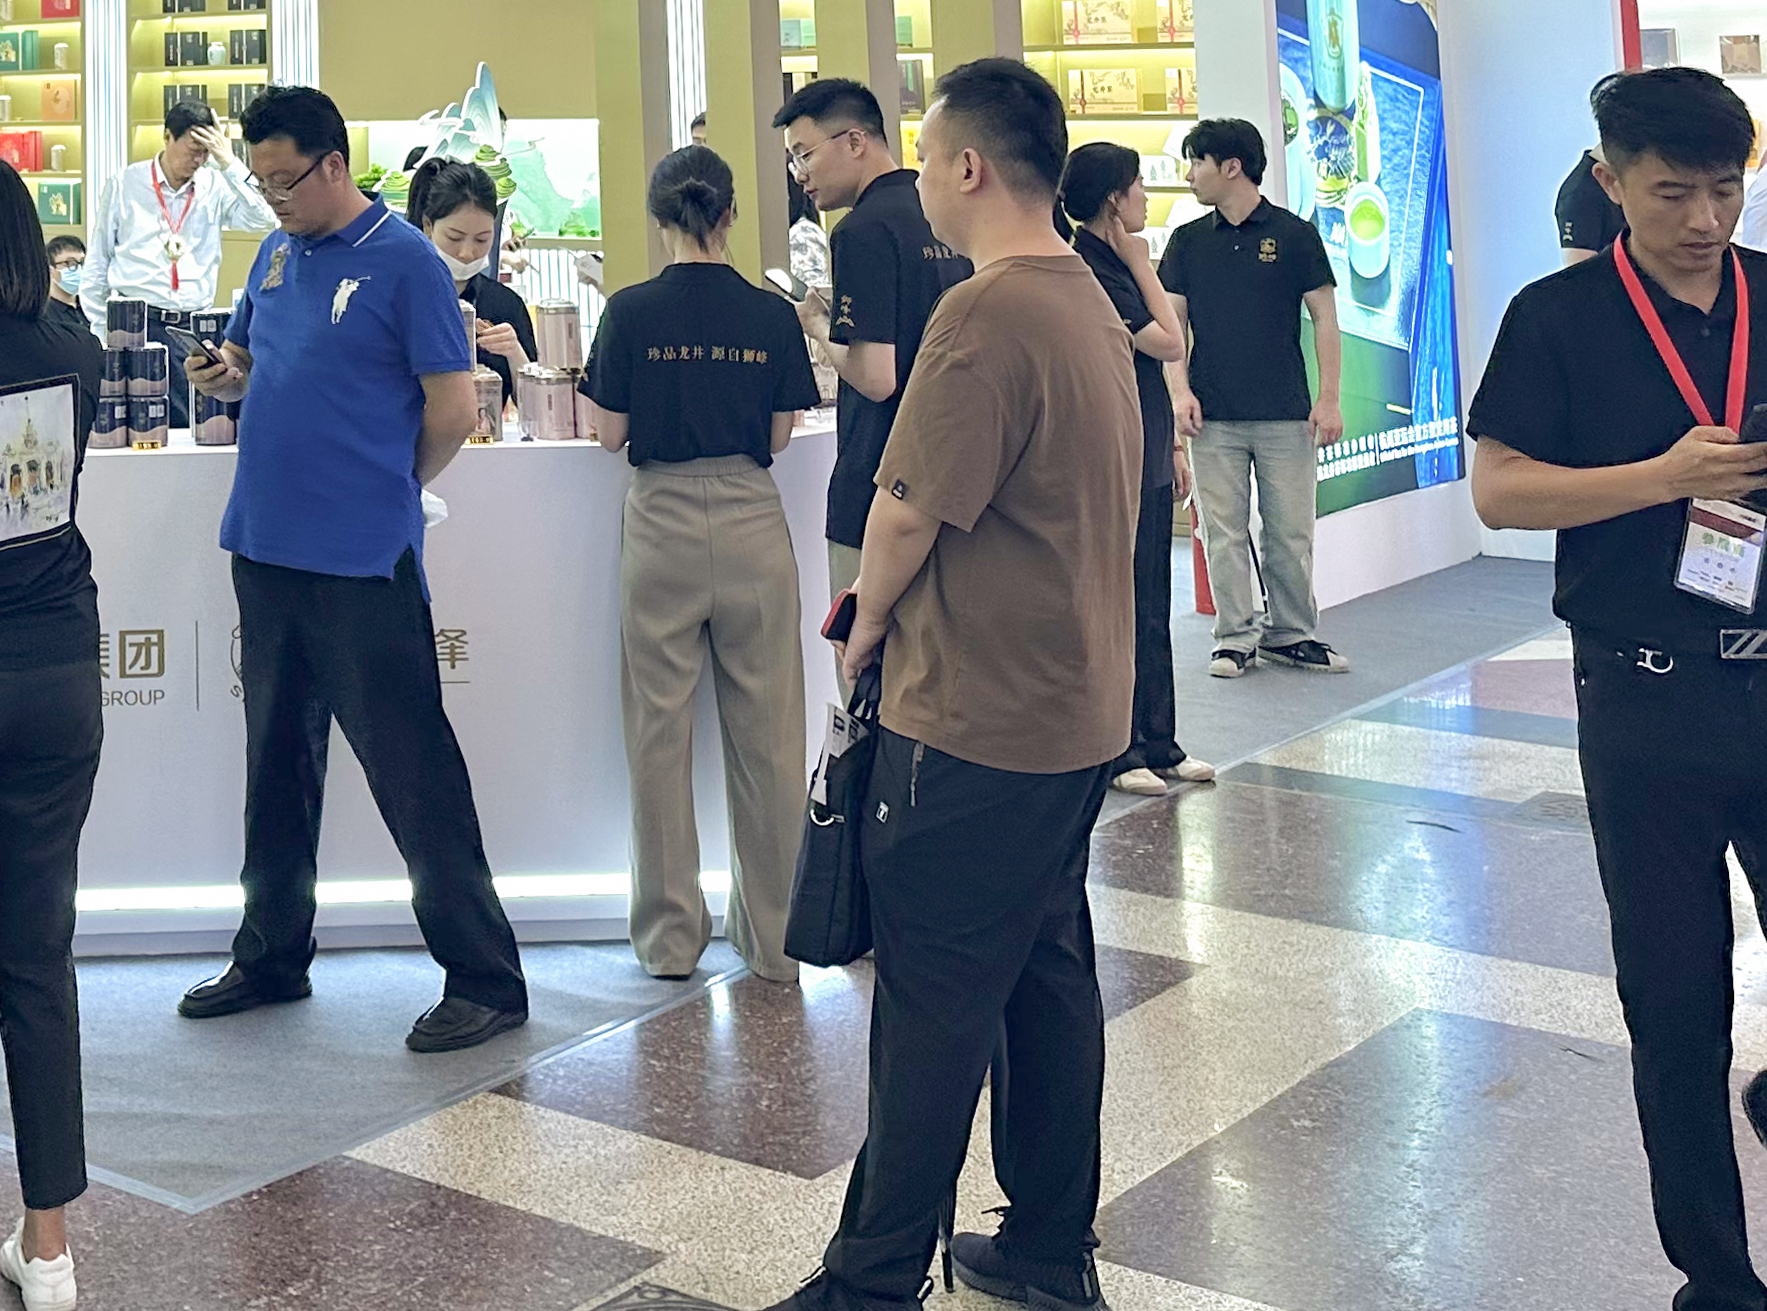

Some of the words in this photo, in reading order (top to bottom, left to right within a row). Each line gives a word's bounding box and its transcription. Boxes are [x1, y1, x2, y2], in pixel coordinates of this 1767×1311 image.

[647, 345, 705, 362] 珍品龙井
[711, 345, 768, 365] 源自狮峰
